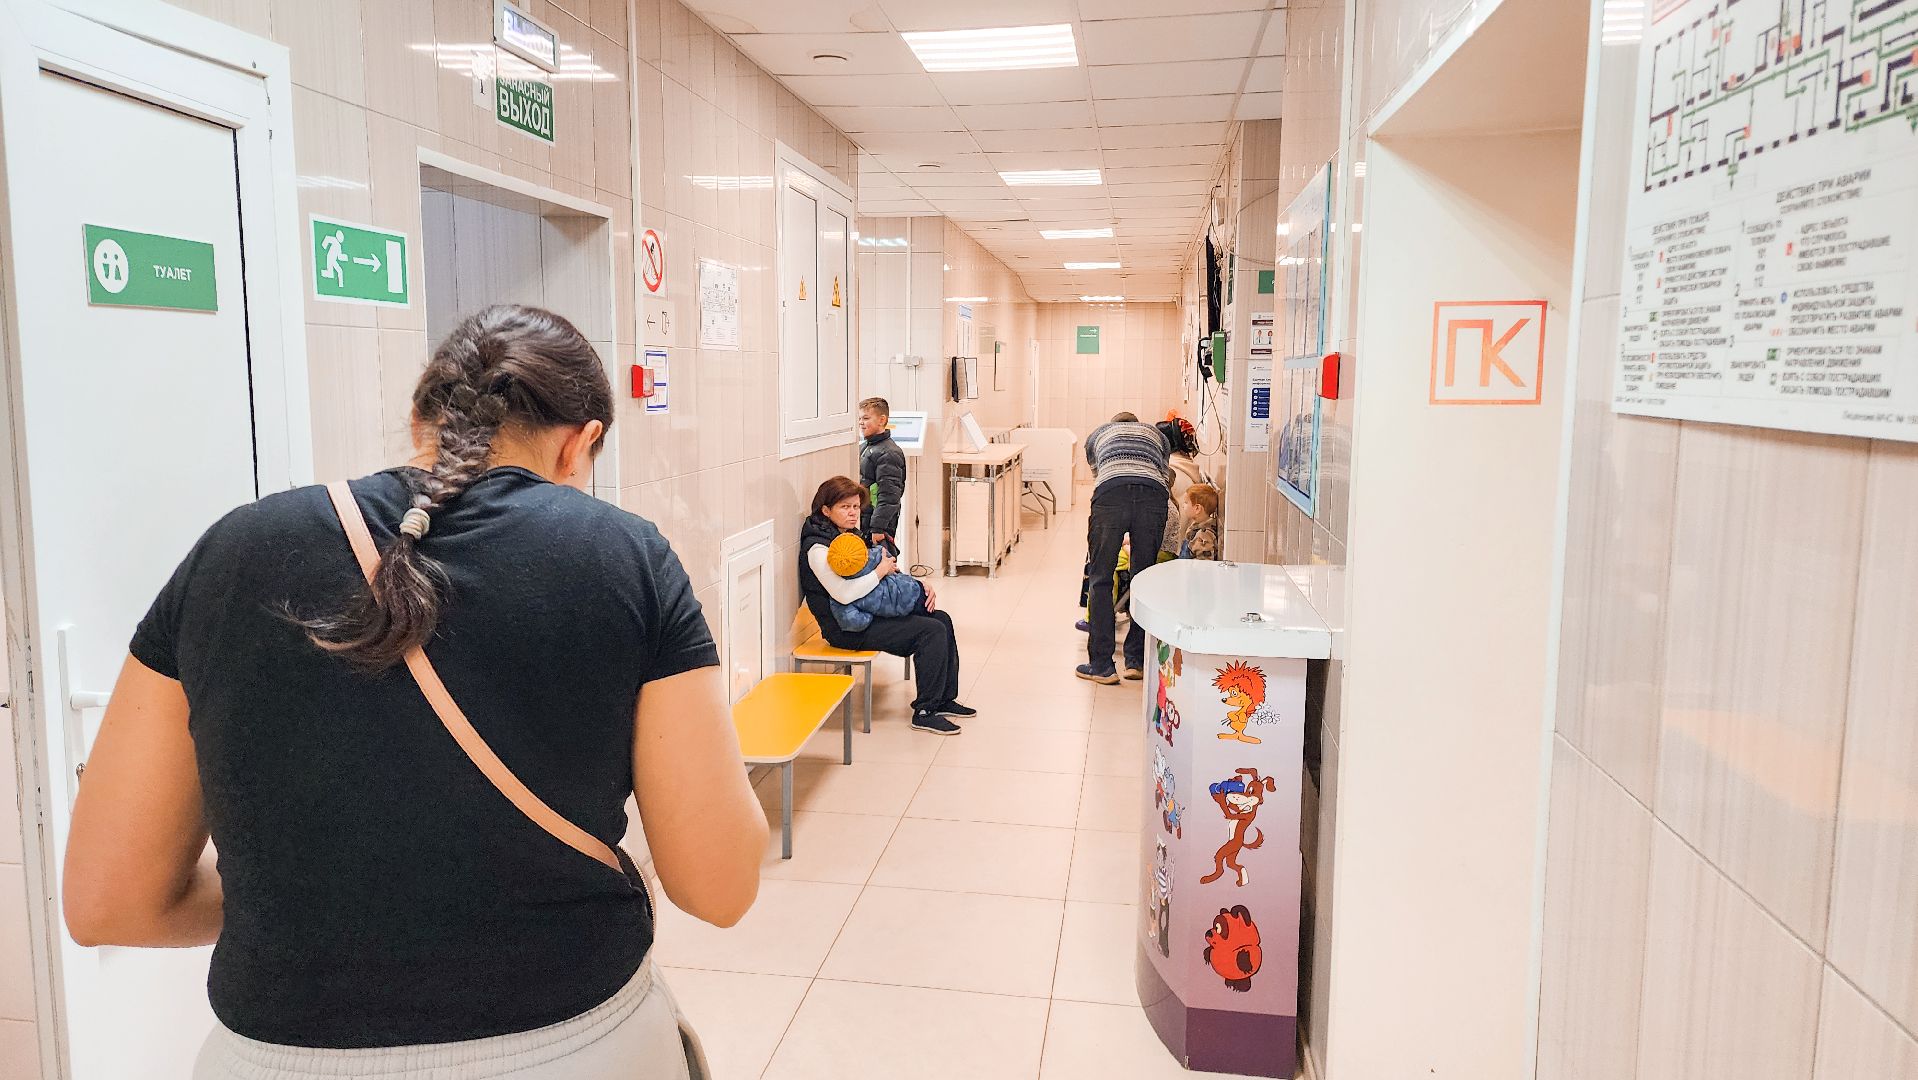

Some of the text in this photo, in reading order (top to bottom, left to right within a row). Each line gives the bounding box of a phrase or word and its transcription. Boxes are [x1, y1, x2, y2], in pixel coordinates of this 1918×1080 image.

[500, 86, 551, 138] ВЫХОД
[153, 264, 192, 281] ТУАЛЕТ
[1445, 318, 1531, 387] ПК
